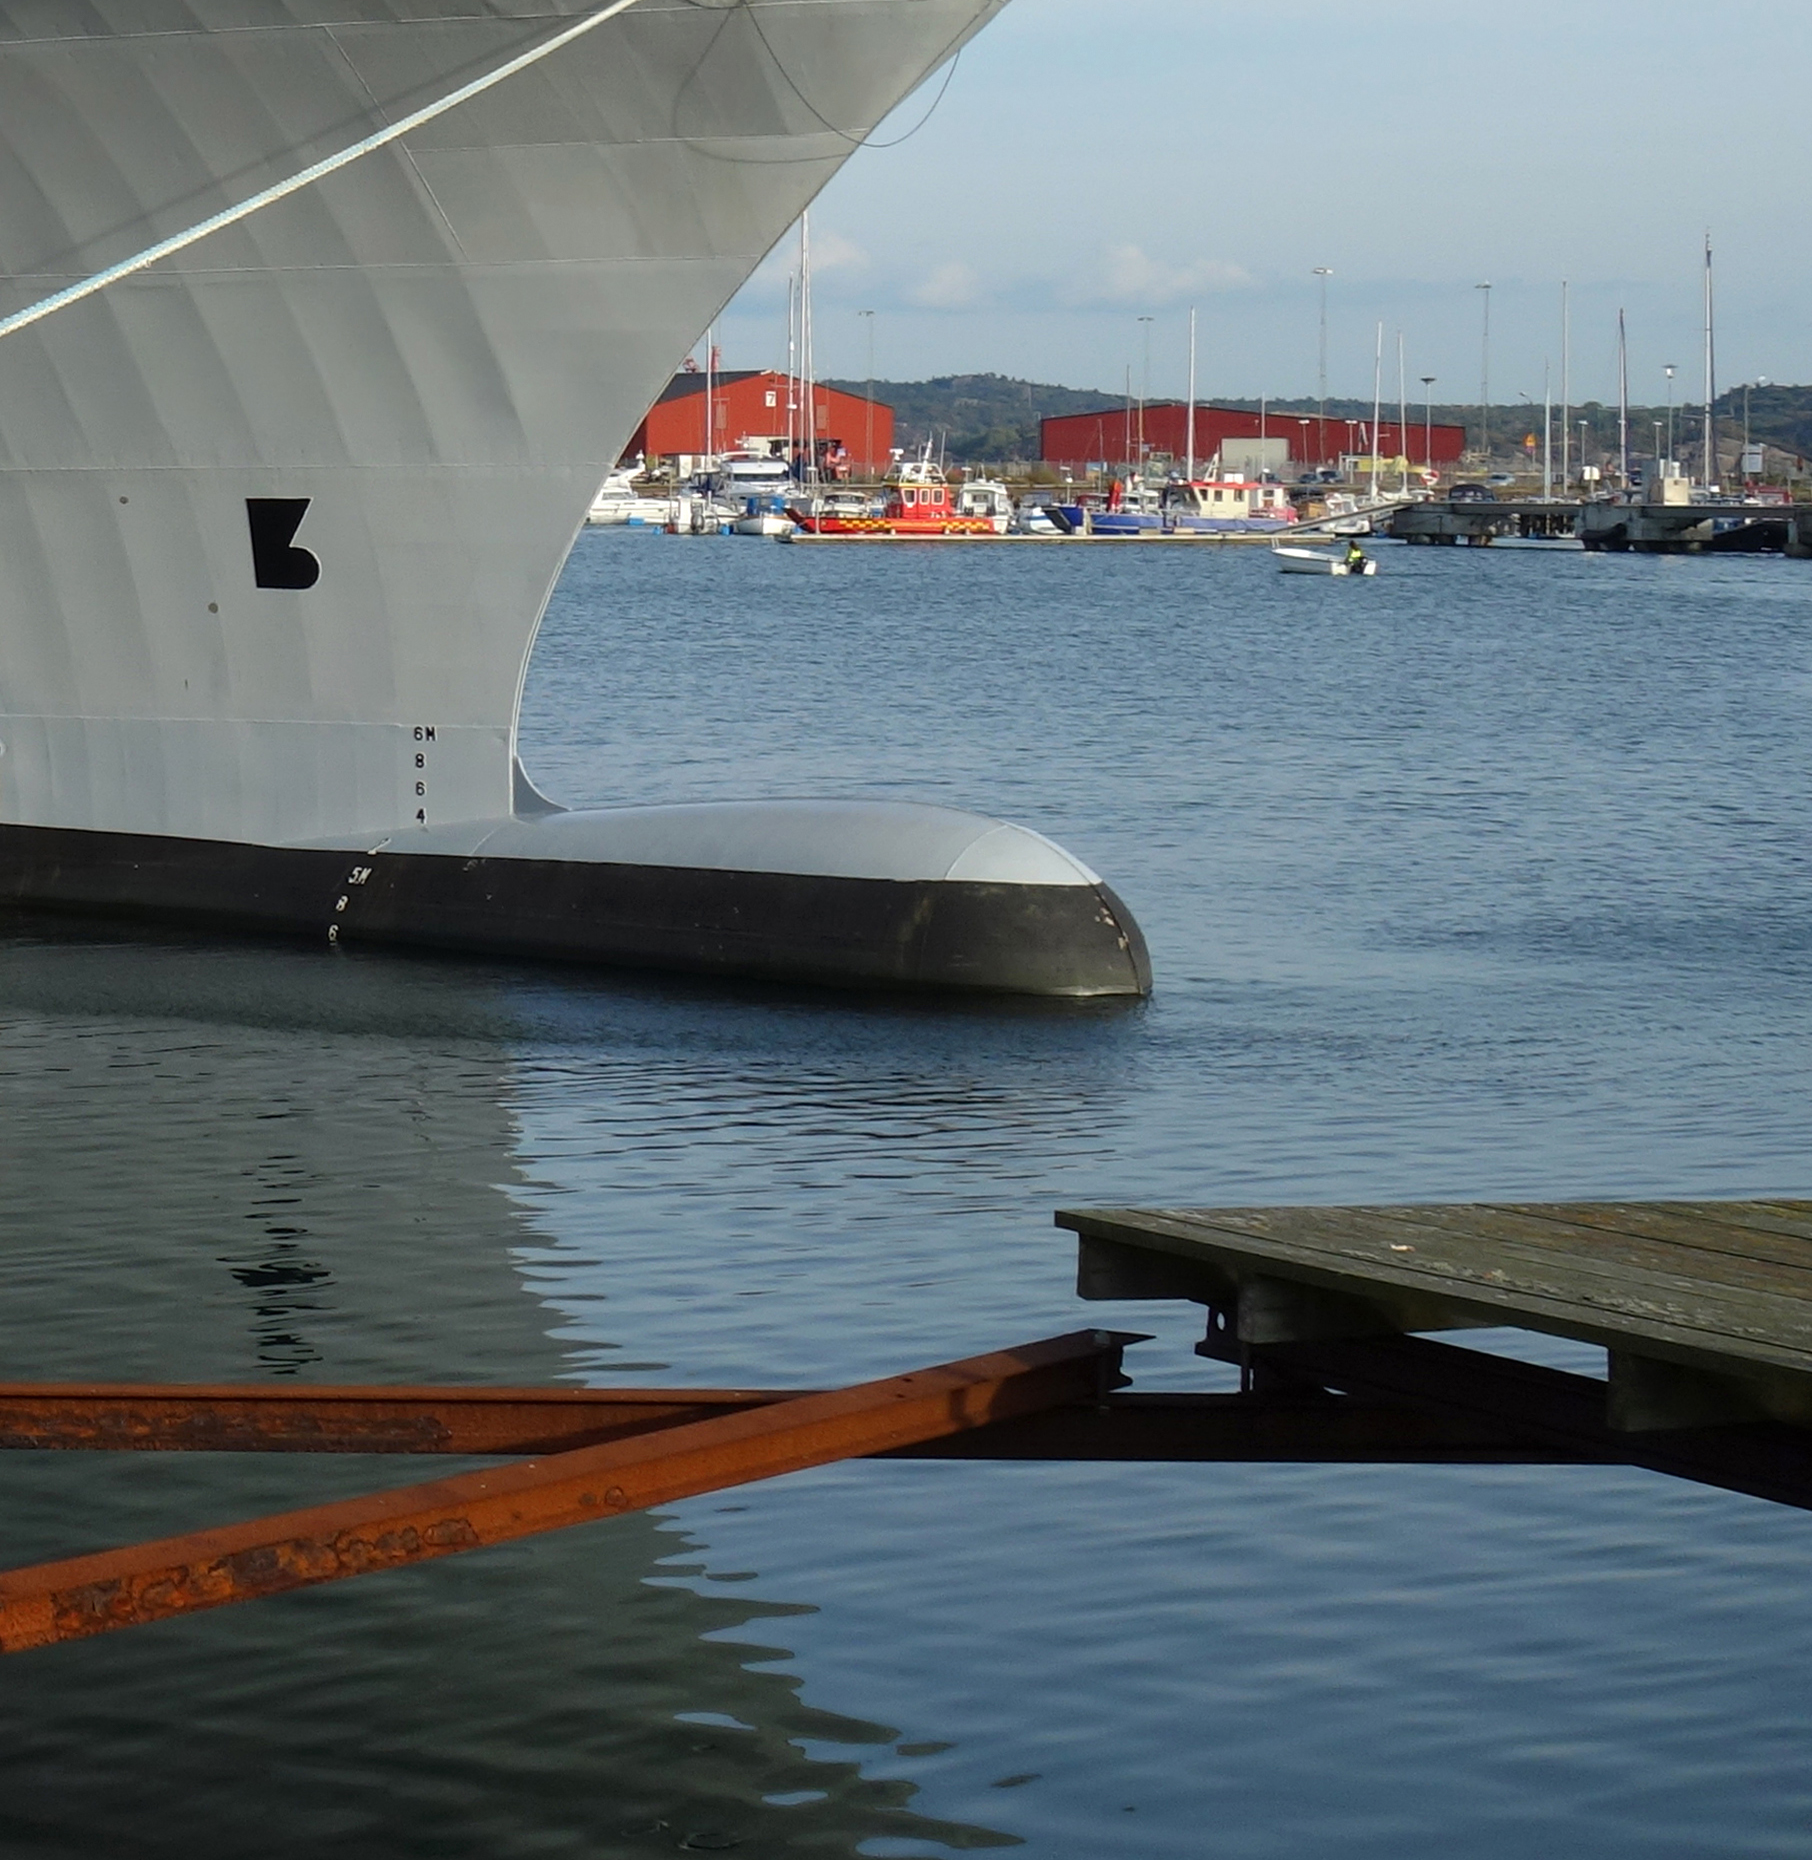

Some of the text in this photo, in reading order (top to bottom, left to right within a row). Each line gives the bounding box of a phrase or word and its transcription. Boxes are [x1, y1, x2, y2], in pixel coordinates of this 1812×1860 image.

[415, 753, 425, 769] 8
[415, 781, 426, 796] 6
[415, 808, 426, 824] 4
[336, 895, 349, 911] 8
[328, 924, 339, 941] 6
